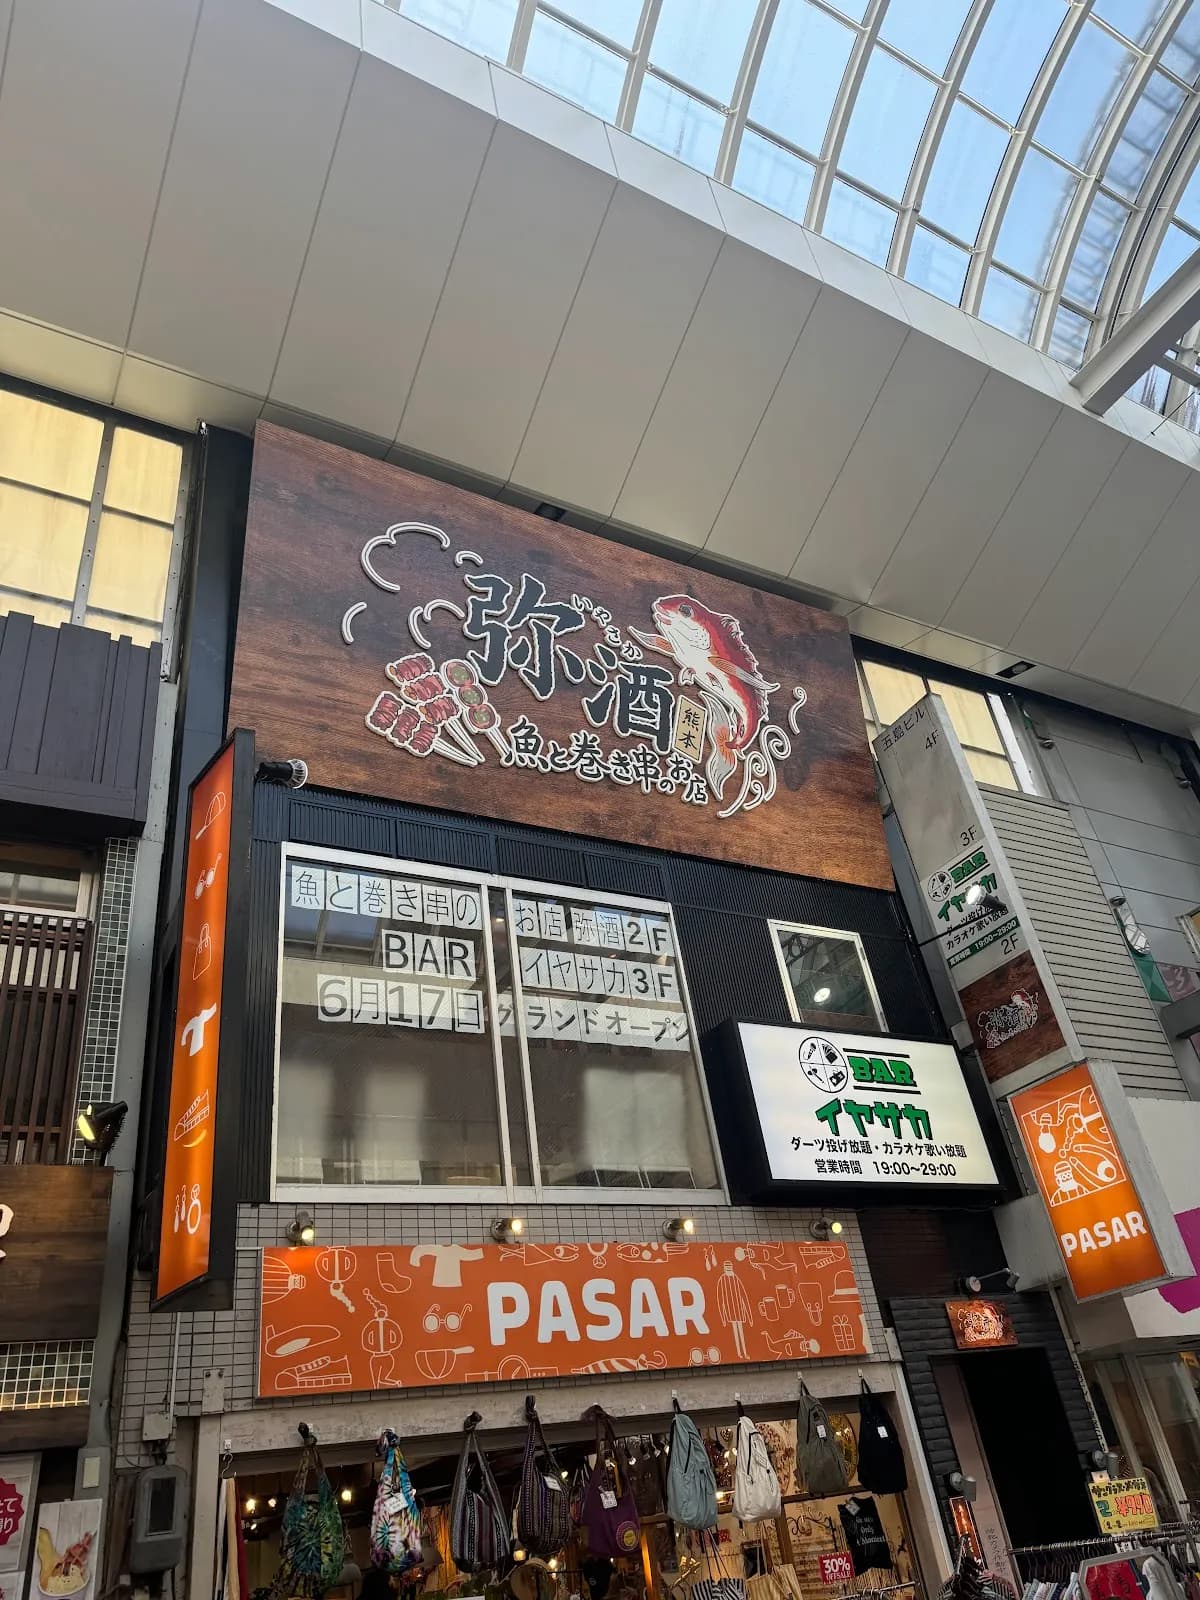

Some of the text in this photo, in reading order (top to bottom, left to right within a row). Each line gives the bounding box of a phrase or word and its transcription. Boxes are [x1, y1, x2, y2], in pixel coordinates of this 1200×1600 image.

[571, 594, 642, 661] いやさか
[678, 708, 699, 751] 熊本
[925, 730, 939, 750] 4F
[505, 717, 709, 804] 魚と巻き串のお店
[960, 825, 977, 847] 3F
[950, 851, 988, 884] BAR
[938, 873, 998, 922] イヤカ
[385, 933, 472, 977] BAR
[1001, 932, 1019, 955] 2F
[319, 979, 481, 1028] 6月17日
[847, 1055, 917, 1087] BAR
[815, 1097, 934, 1141] イヤサカ
[814, 1158, 863, 1175] 営業時間
[1060, 1210, 1147, 1258] PASAR
[487, 1277, 711, 1346] PASAR
[823, 1557, 850, 1574] 30%
